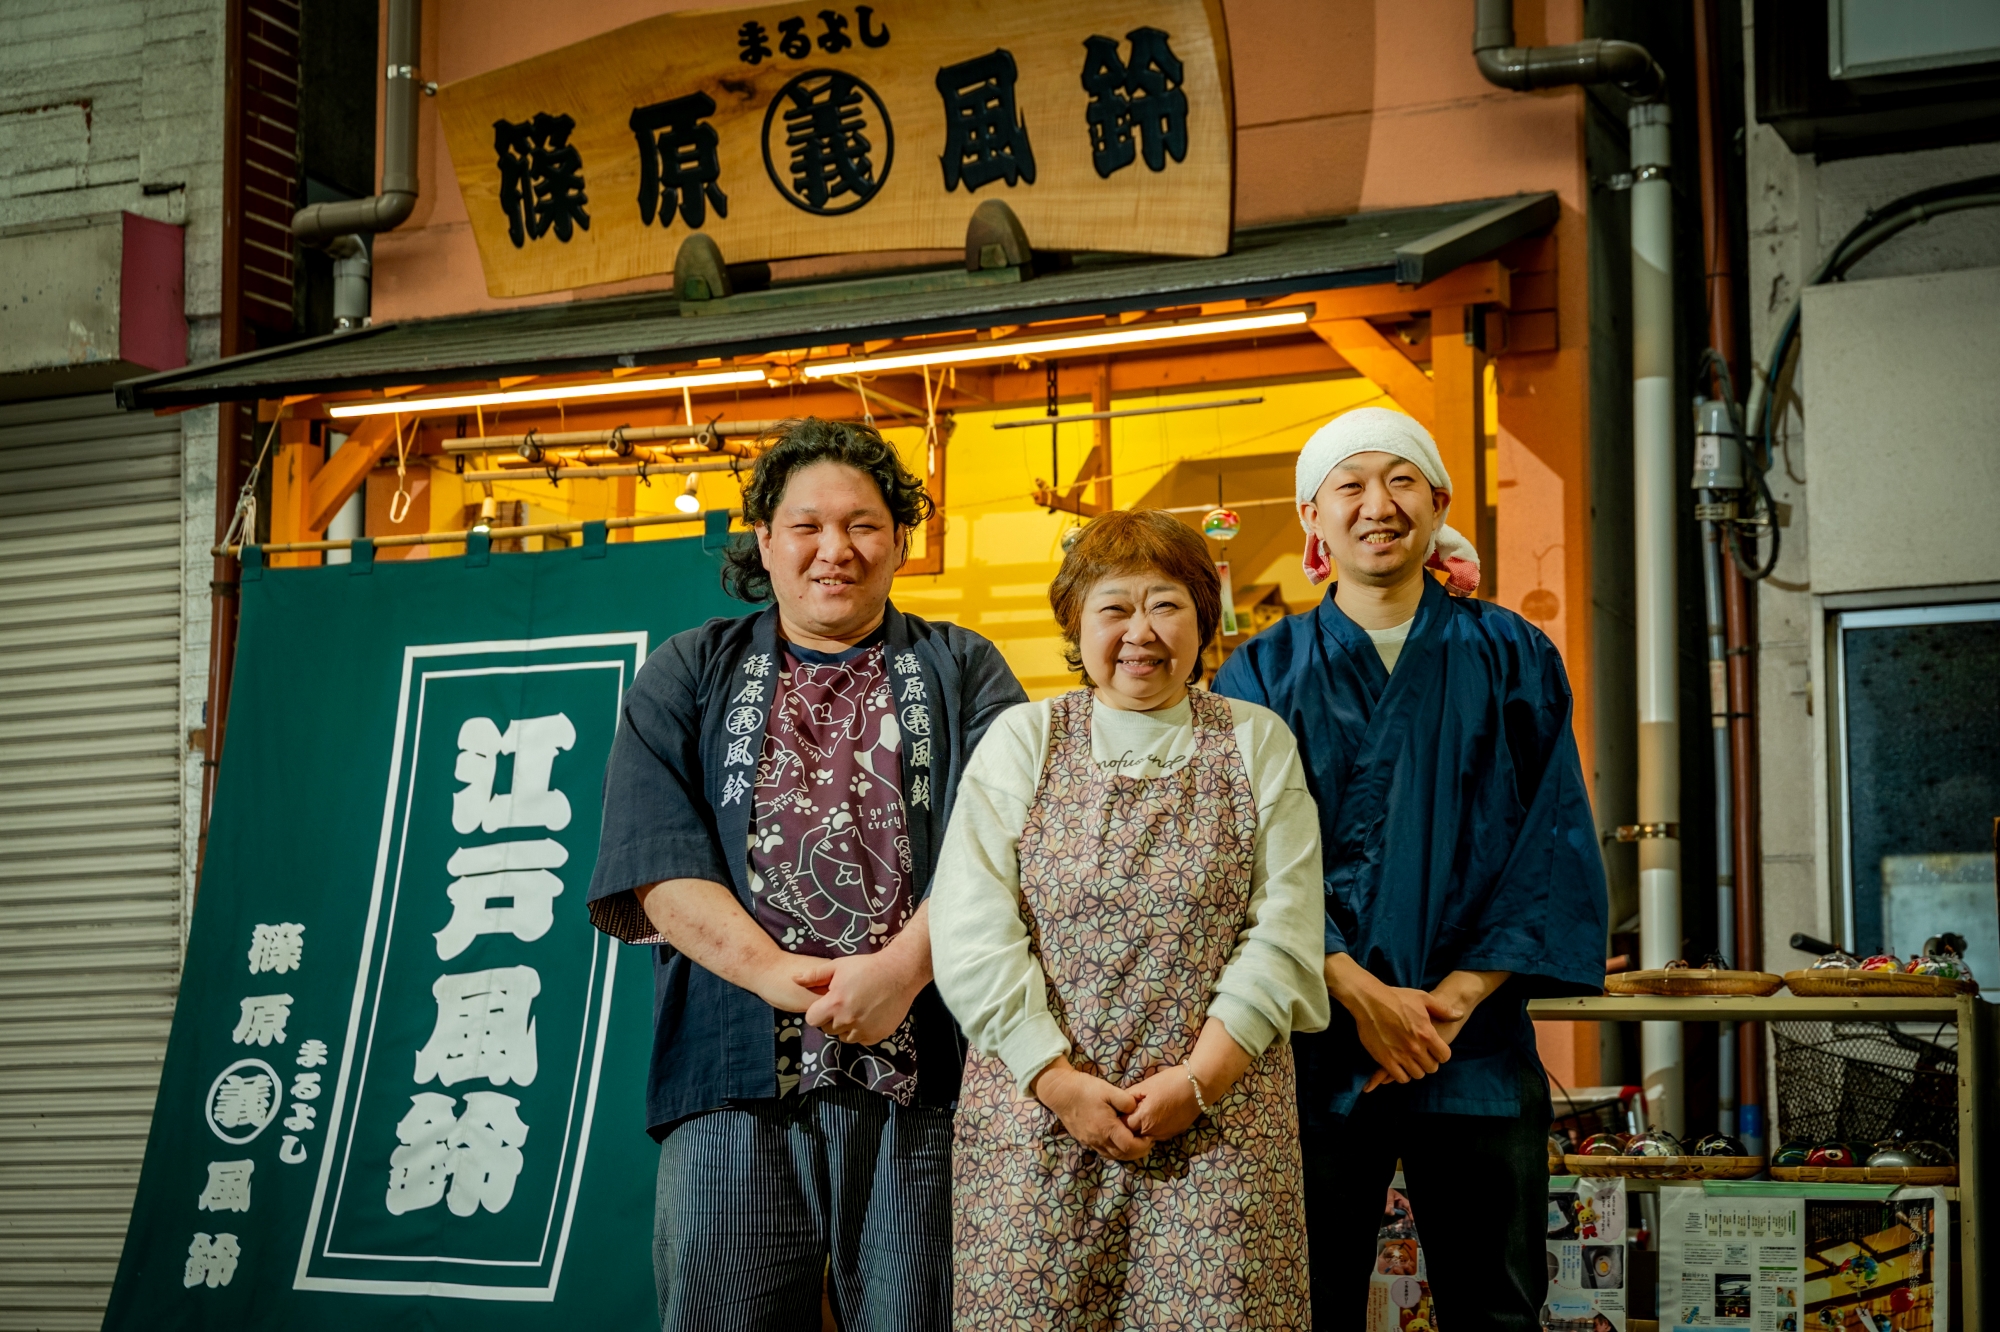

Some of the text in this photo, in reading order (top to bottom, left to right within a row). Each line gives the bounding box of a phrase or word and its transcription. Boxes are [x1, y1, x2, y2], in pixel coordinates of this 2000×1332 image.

[738, 4, 891, 66] まるよし
[856, 798, 903, 821] I go int
[867, 816, 902, 830] every
[764, 866, 791, 909] like the
[779, 861, 809, 910] Osakanya
[384, 711, 577, 1218] 江戸風鈴
[278, 1038, 328, 1165] まるよし
